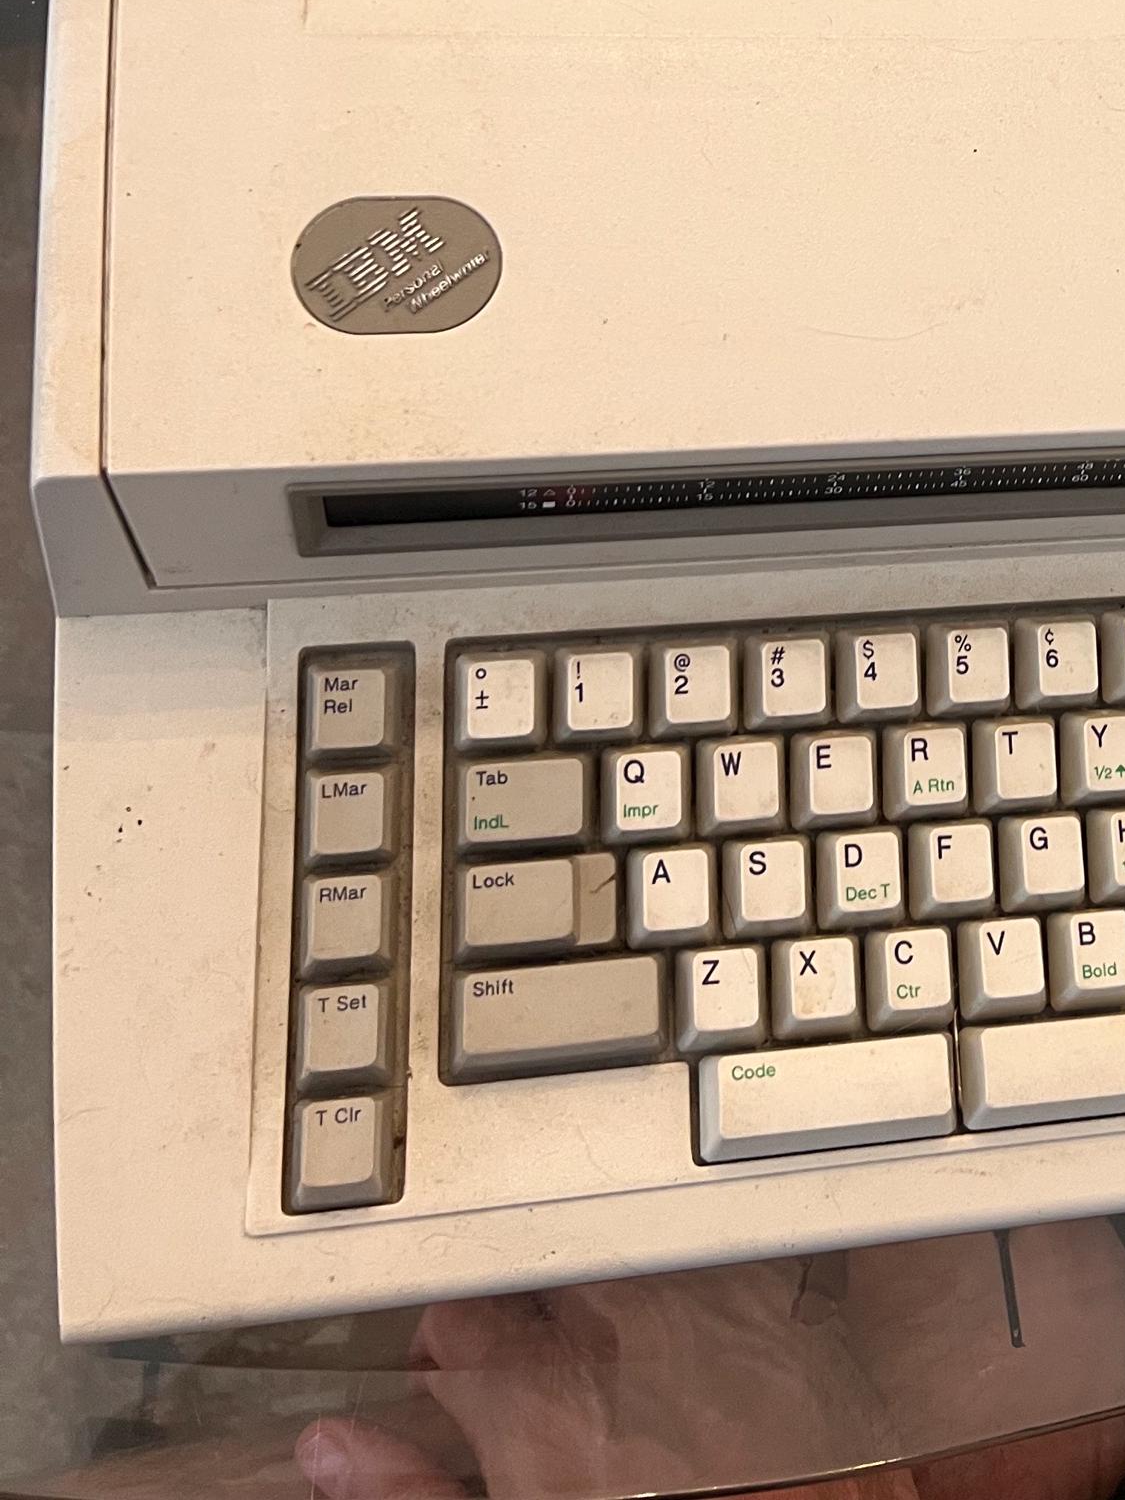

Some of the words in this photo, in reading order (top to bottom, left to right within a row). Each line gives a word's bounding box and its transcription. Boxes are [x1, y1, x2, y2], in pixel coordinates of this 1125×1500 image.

[305, 207, 445, 321] IBM
[824, 486, 843, 494] 30
[951, 479, 968, 488] 45
[863, 641, 874, 659] $
[954, 635, 972, 652] %
[674, 654, 691, 672] @
[770, 646, 785, 664] #
[1045, 650, 1058, 668] 6
[864, 663, 877, 680] 4
[956, 656, 969, 675] 5
[324, 678, 358, 692] Mar
[674, 676, 689, 694] 2
[771, 668, 784, 687] 3
[575, 684, 584, 702] 1
[324, 700, 353, 714] Rel
[1002, 731, 1019, 754] T
[1091, 725, 1108, 747] Y
[816, 745, 831, 769] E
[911, 739, 928, 761] R
[624, 760, 645, 785] Q
[721, 752, 742, 775] W
[475, 771, 508, 786] Tab
[913, 780, 923, 793] A
[928, 778, 955, 792] Rtn
[321, 782, 367, 798] LMar
[623, 803, 658, 818] Impr
[937, 835, 952, 859] F
[1029, 827, 1049, 850] G
[749, 851, 767, 875] S
[844, 844, 863, 868] D
[472, 873, 515, 888] Lock
[651, 860, 671, 884] A
[319, 885, 366, 902] RMar
[846, 886, 877, 901] Dec
[879, 884, 890, 898] T
[987, 931, 1005, 954] V
[1079, 923, 1095, 945] B
[895, 941, 913, 964] C
[799, 951, 818, 975] X
[1082, 962, 1117, 978] Bold
[702, 960, 720, 985] Z
[472, 980, 514, 996] Shift
[897, 985, 921, 999] Ctr
[317, 998, 329, 1013] T
[336, 995, 366, 1010] Set
[731, 1064, 776, 1081] Code
[316, 1111, 327, 1125] T
[334, 1108, 361, 1124] Clr
